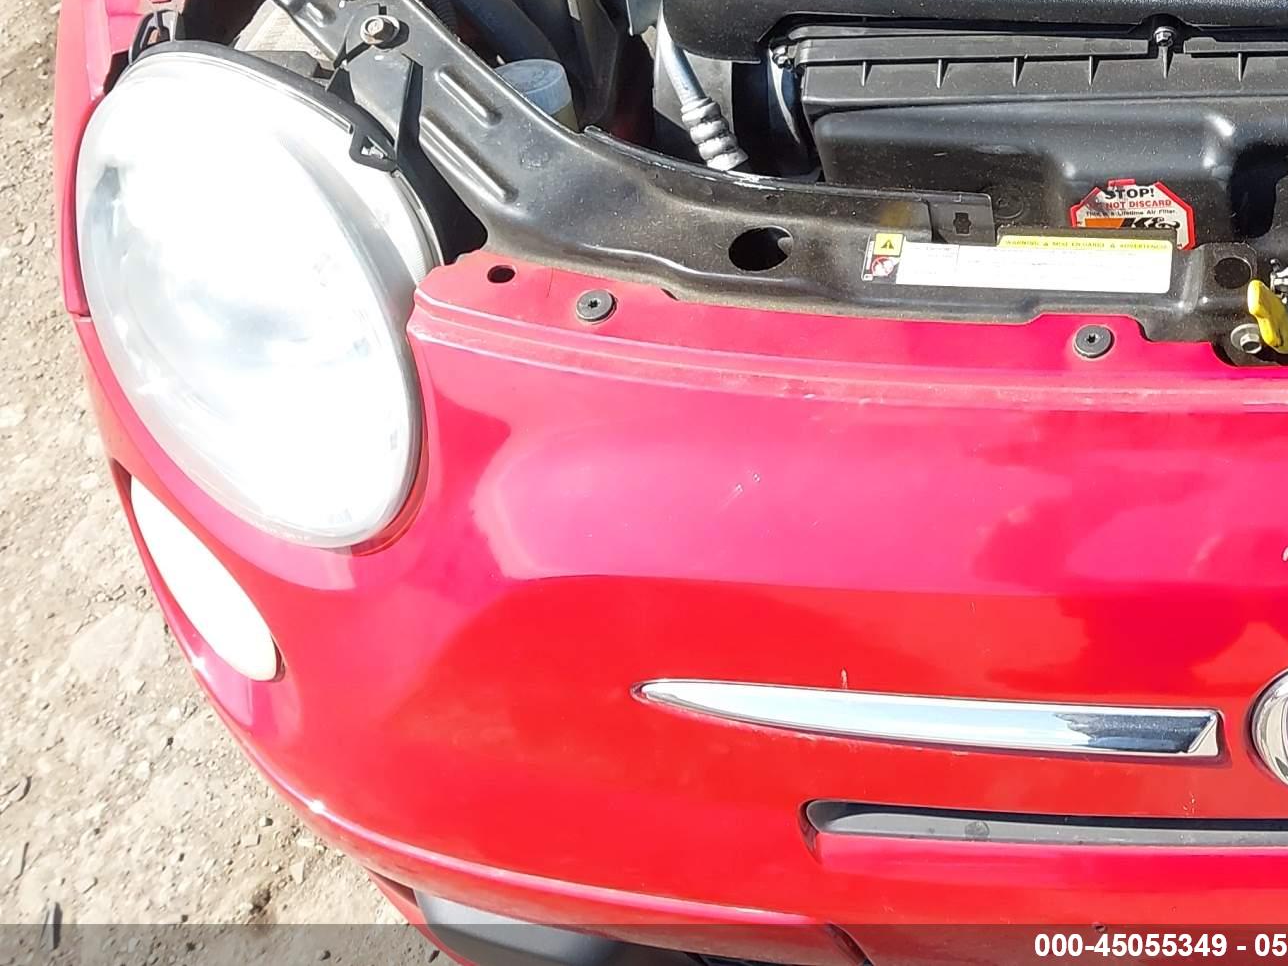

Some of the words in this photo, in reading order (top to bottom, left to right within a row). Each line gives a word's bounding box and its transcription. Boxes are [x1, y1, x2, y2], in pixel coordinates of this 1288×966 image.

[1105, 187, 1154, 199] STOP!
[1105, 201, 1126, 209] NOT
[1129, 199, 1172, 209] DISCARD
